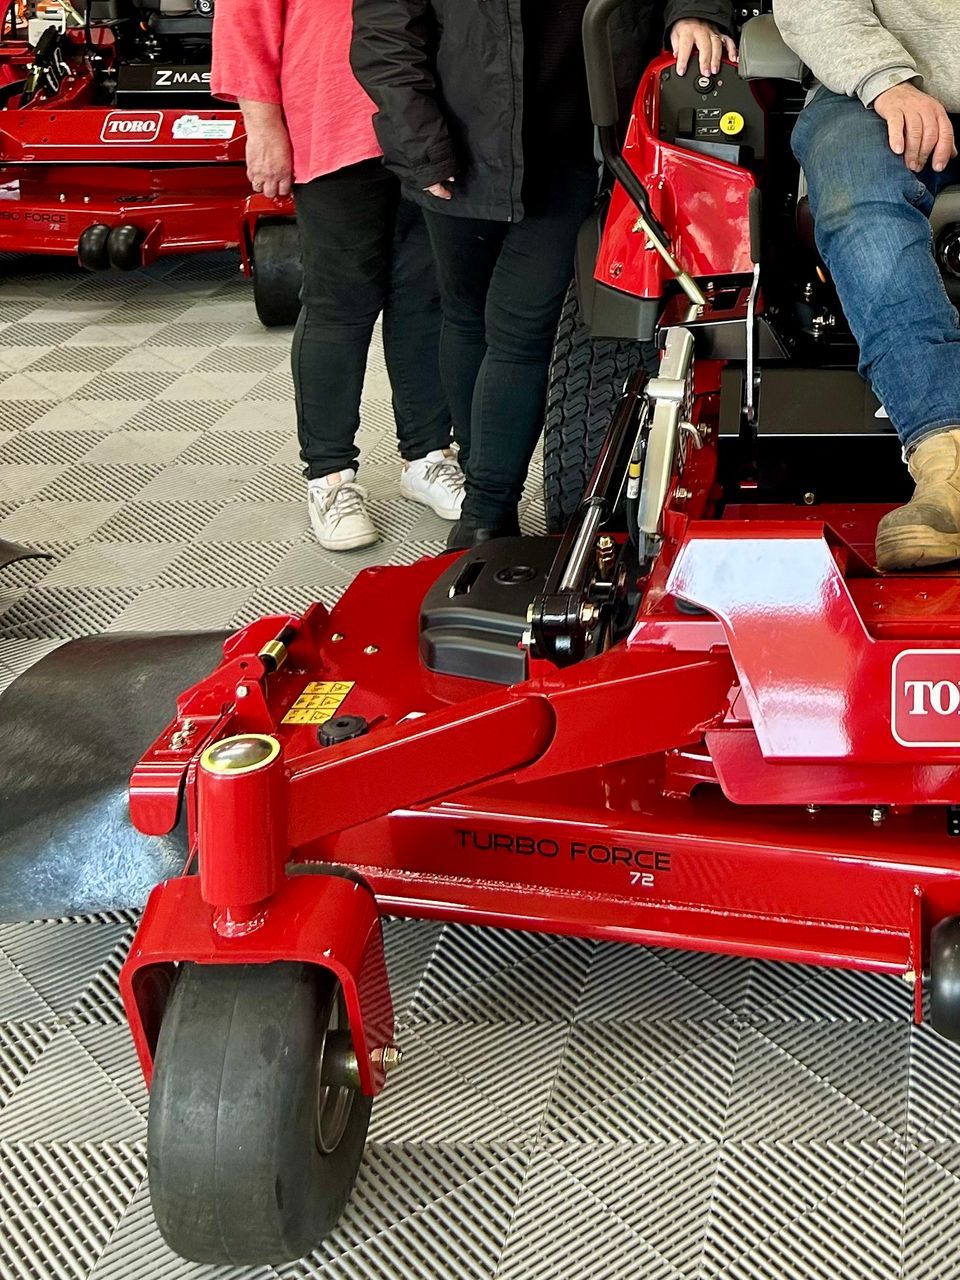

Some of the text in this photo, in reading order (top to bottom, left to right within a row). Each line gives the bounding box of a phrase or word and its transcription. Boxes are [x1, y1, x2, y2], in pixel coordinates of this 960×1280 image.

[108, 120, 158, 133] TORO
[25, 211, 67, 223] FORCE
[49, 223, 60, 231] 72
[455, 829, 672, 871] TURBO FORCE
[629, 871, 655, 887] 72
